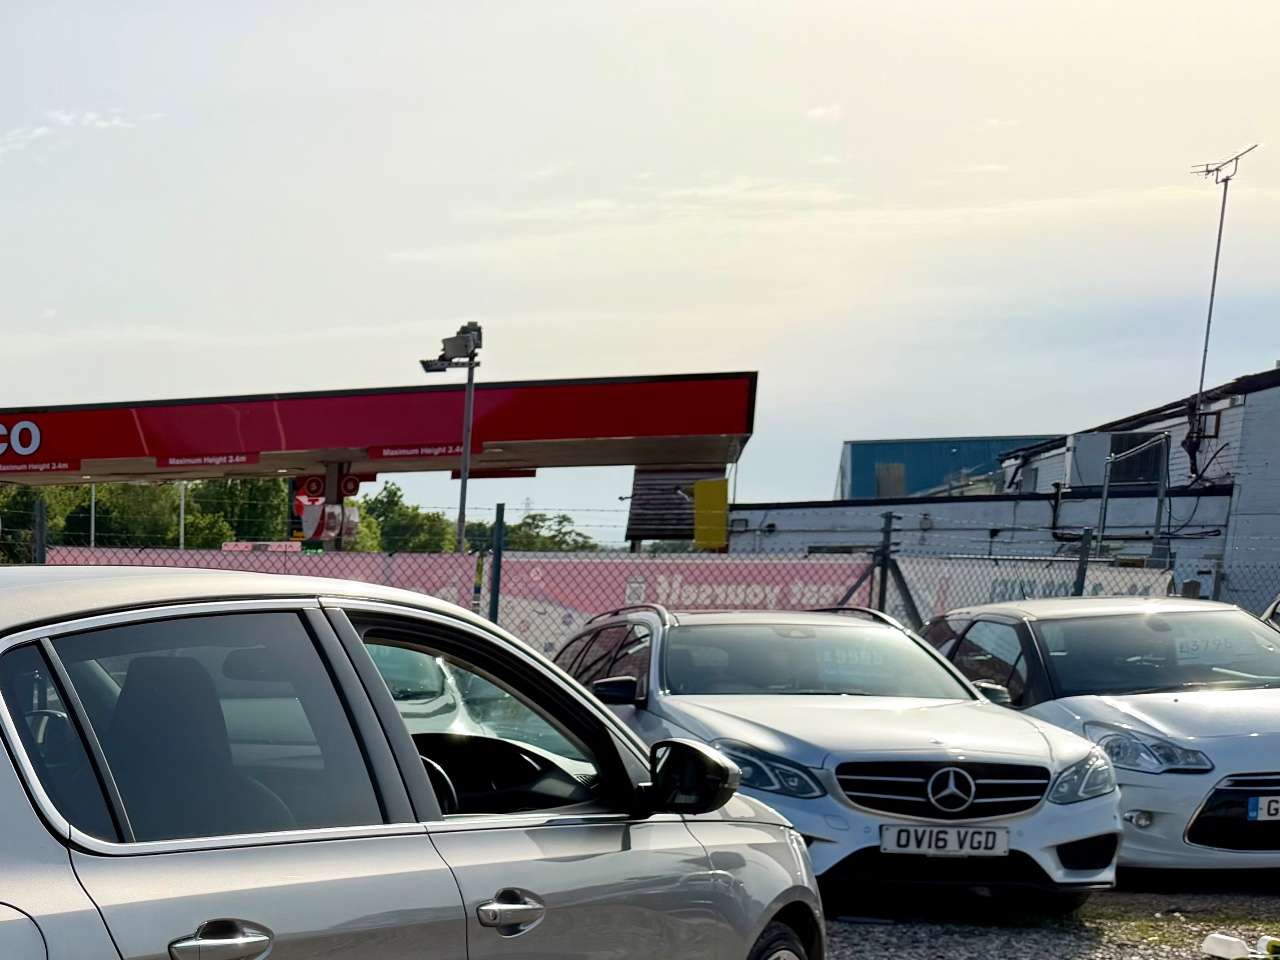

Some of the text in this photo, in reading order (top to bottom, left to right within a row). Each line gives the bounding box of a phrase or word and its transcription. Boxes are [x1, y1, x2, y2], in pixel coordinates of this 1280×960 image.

[382, 445, 464, 456] Maximum Height 3.4
[168, 457, 202, 465] Maximum
[203, 455, 227, 465] Height
[28, 462, 50, 472] Height
[896, 828, 997, 851] OV16 VGD
